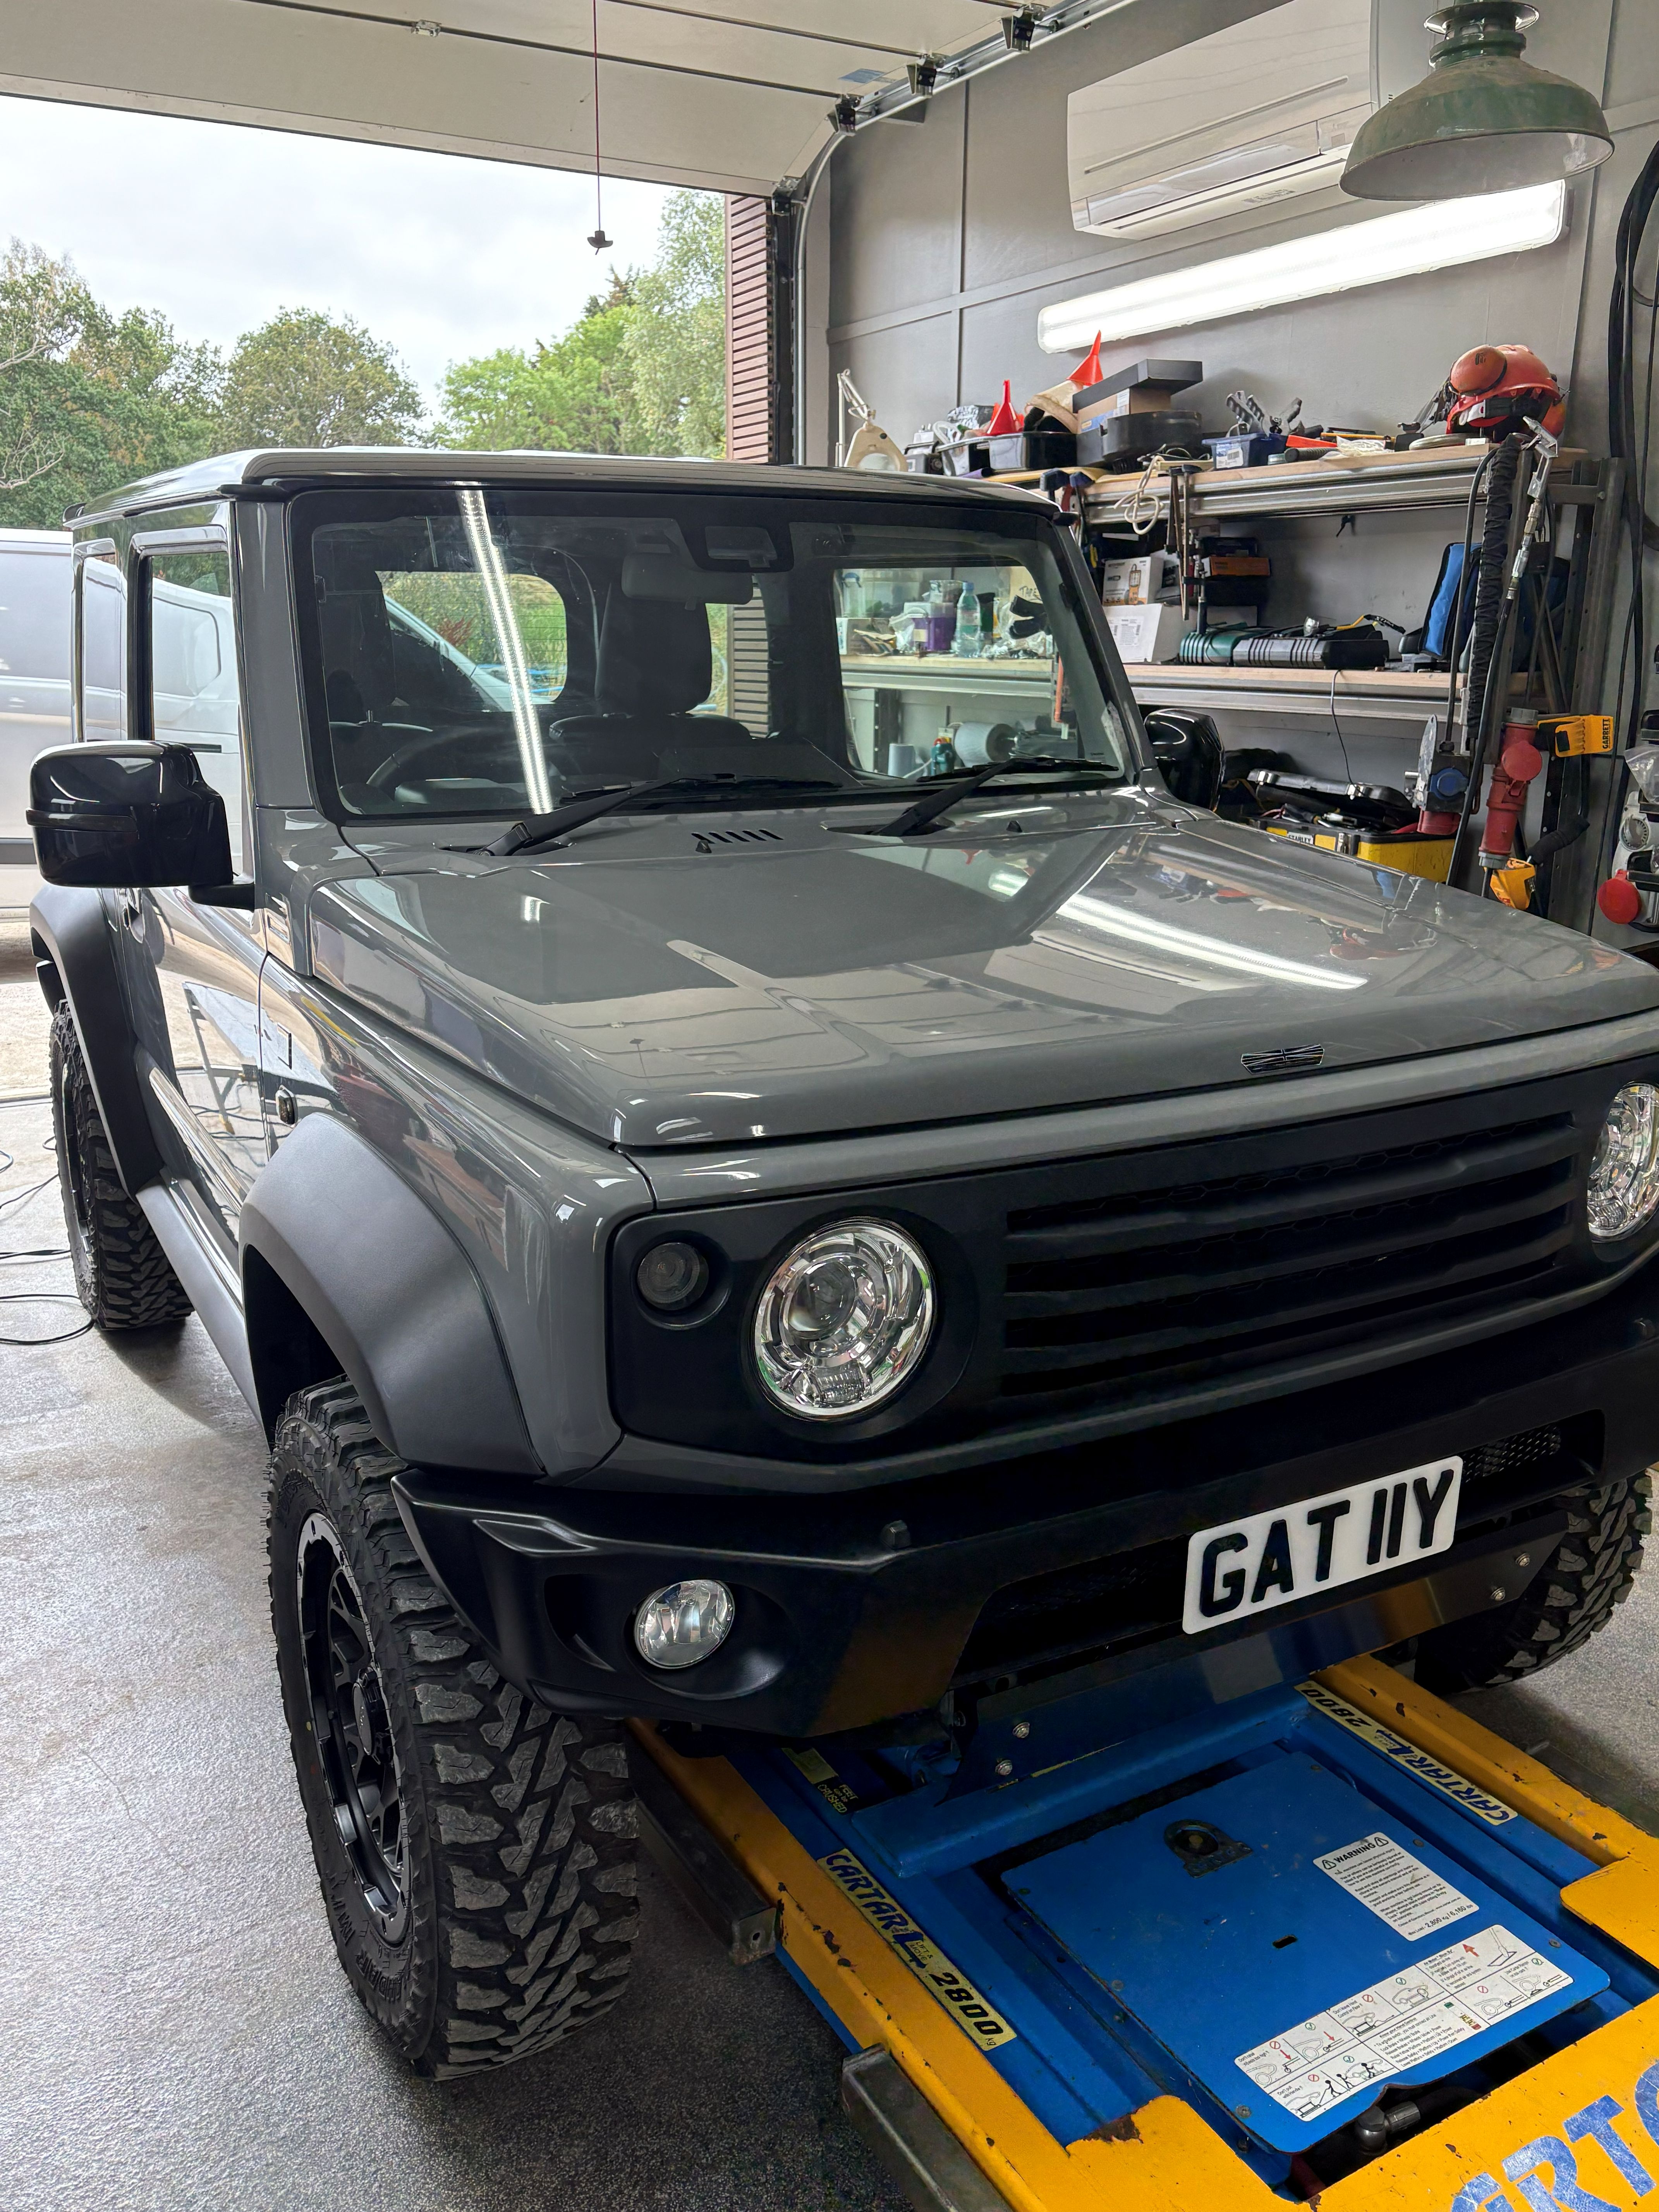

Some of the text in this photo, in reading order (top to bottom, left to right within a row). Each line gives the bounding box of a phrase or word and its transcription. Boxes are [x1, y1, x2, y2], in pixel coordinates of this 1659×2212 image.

[1288, 835, 1311, 845] STANLEY
[1199, 1499, 1351, 1618] GAT
[1301, 1689, 1372, 1727] 2800
[1334, 1843, 1375, 1862] WARNING
[1425, 1918, 1441, 1927] 2,800
[1449, 1906, 1466, 1915] 6,160
[910, 1944, 927, 1961] MOVE
[916, 1941, 929, 1954] LIFT
[929, 1972, 1004, 2035] 2800
